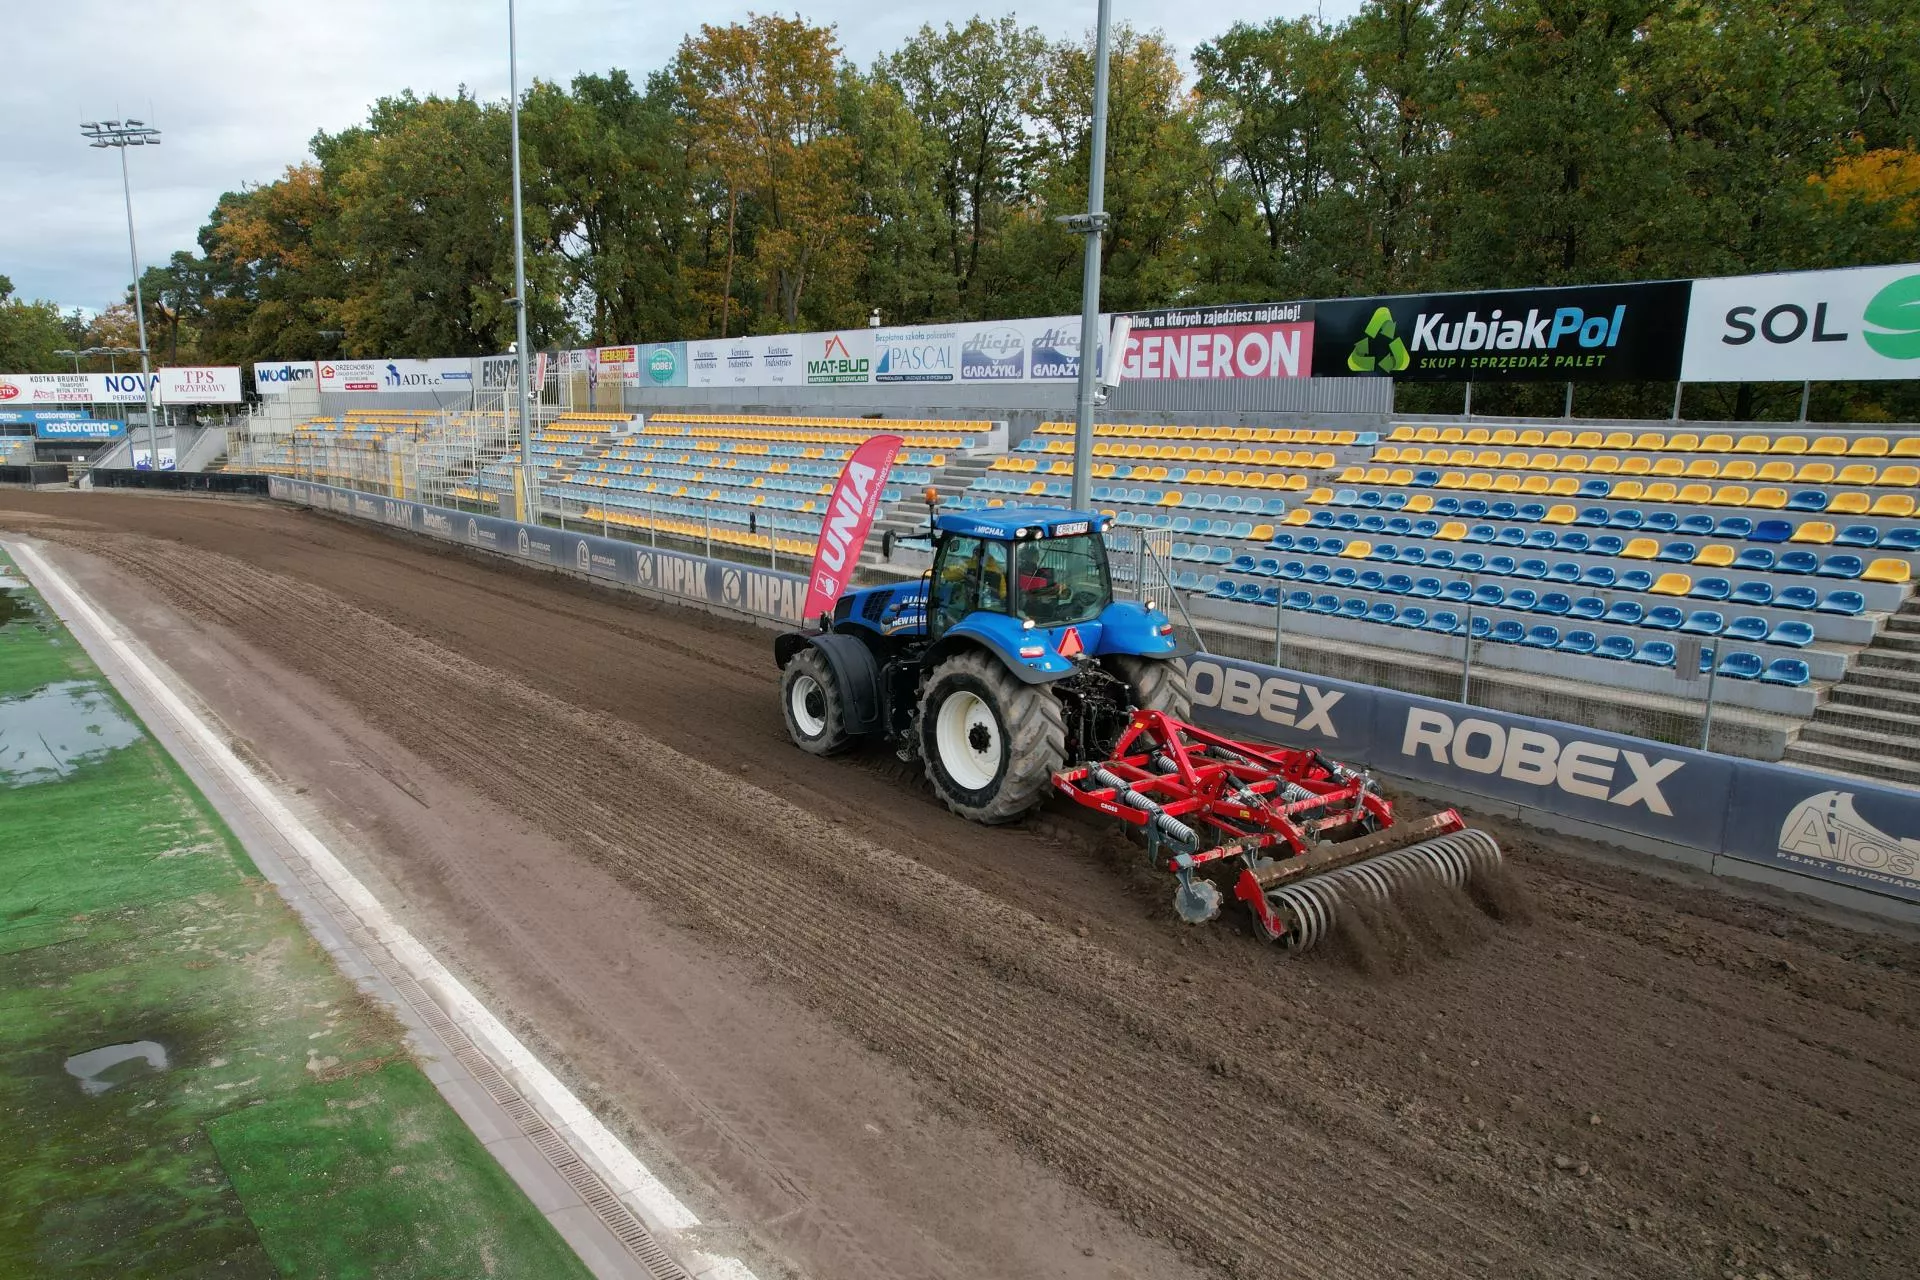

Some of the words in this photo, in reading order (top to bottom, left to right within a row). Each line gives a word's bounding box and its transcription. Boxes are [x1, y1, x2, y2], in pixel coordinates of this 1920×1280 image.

[1154, 317, 1164, 327] na
[1166, 313, 1201, 328] których
[1203, 309, 1253, 325] zajedziesz
[1255, 305, 1301, 322] najdalej!
[1721, 302, 1848, 346] SOL
[1411, 304, 1626, 352] KubiakPol
[962, 333, 1022, 354] Alicja
[651, 361, 673, 370] ROBEX
[765, 358, 792, 368] Industries
[892, 345, 954, 370] PASCAL
[1121, 331, 1301, 379] GENERON
[1420, 357, 1456, 369] SKUP
[1460, 357, 1466, 368] I
[1471, 354, 1550, 368] SPRZEDAŻ
[1555, 355, 1606, 367] PALET
[183, 370, 215, 384] TPS
[258, 365, 314, 382] wodkan
[808, 359, 869, 374] MAT-BUD
[57, 375, 89, 383] BRUKOWA
[174, 384, 226, 393] PRZYPRAWY
[46, 421, 109, 433] castorama
[821, 461, 876, 572] UNIA
[656, 554, 708, 600] INPAK
[1174, 657, 1346, 739] OBEX
[1401, 706, 1687, 817] ROBEX
